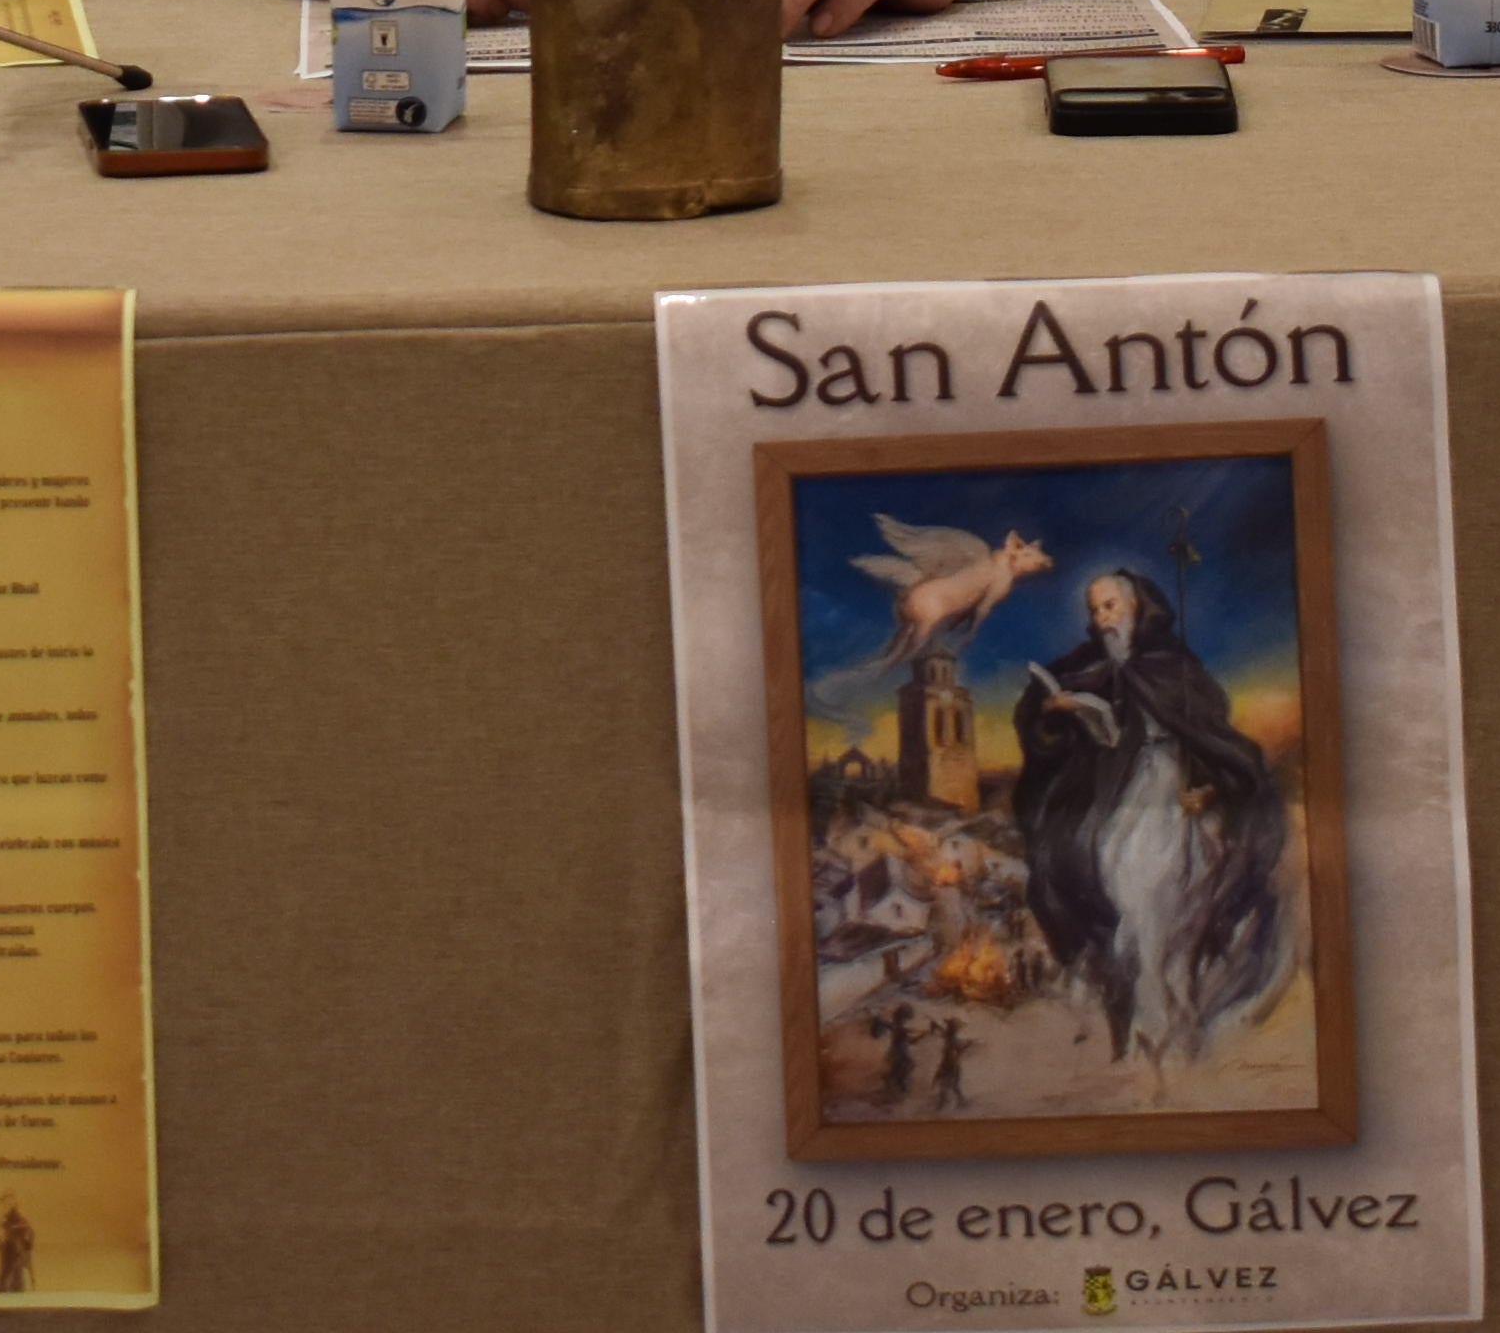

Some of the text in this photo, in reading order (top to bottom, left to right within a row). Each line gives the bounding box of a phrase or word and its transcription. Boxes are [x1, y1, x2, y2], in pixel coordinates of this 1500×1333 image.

[745, 297, 1354, 409] San Antón
[764, 1174, 1421, 1247] 20 de enero, Gálvez
[904, 1279, 1060, 1312] Organiza:
[1125, 1263, 1279, 1292] GÁLVEZ
